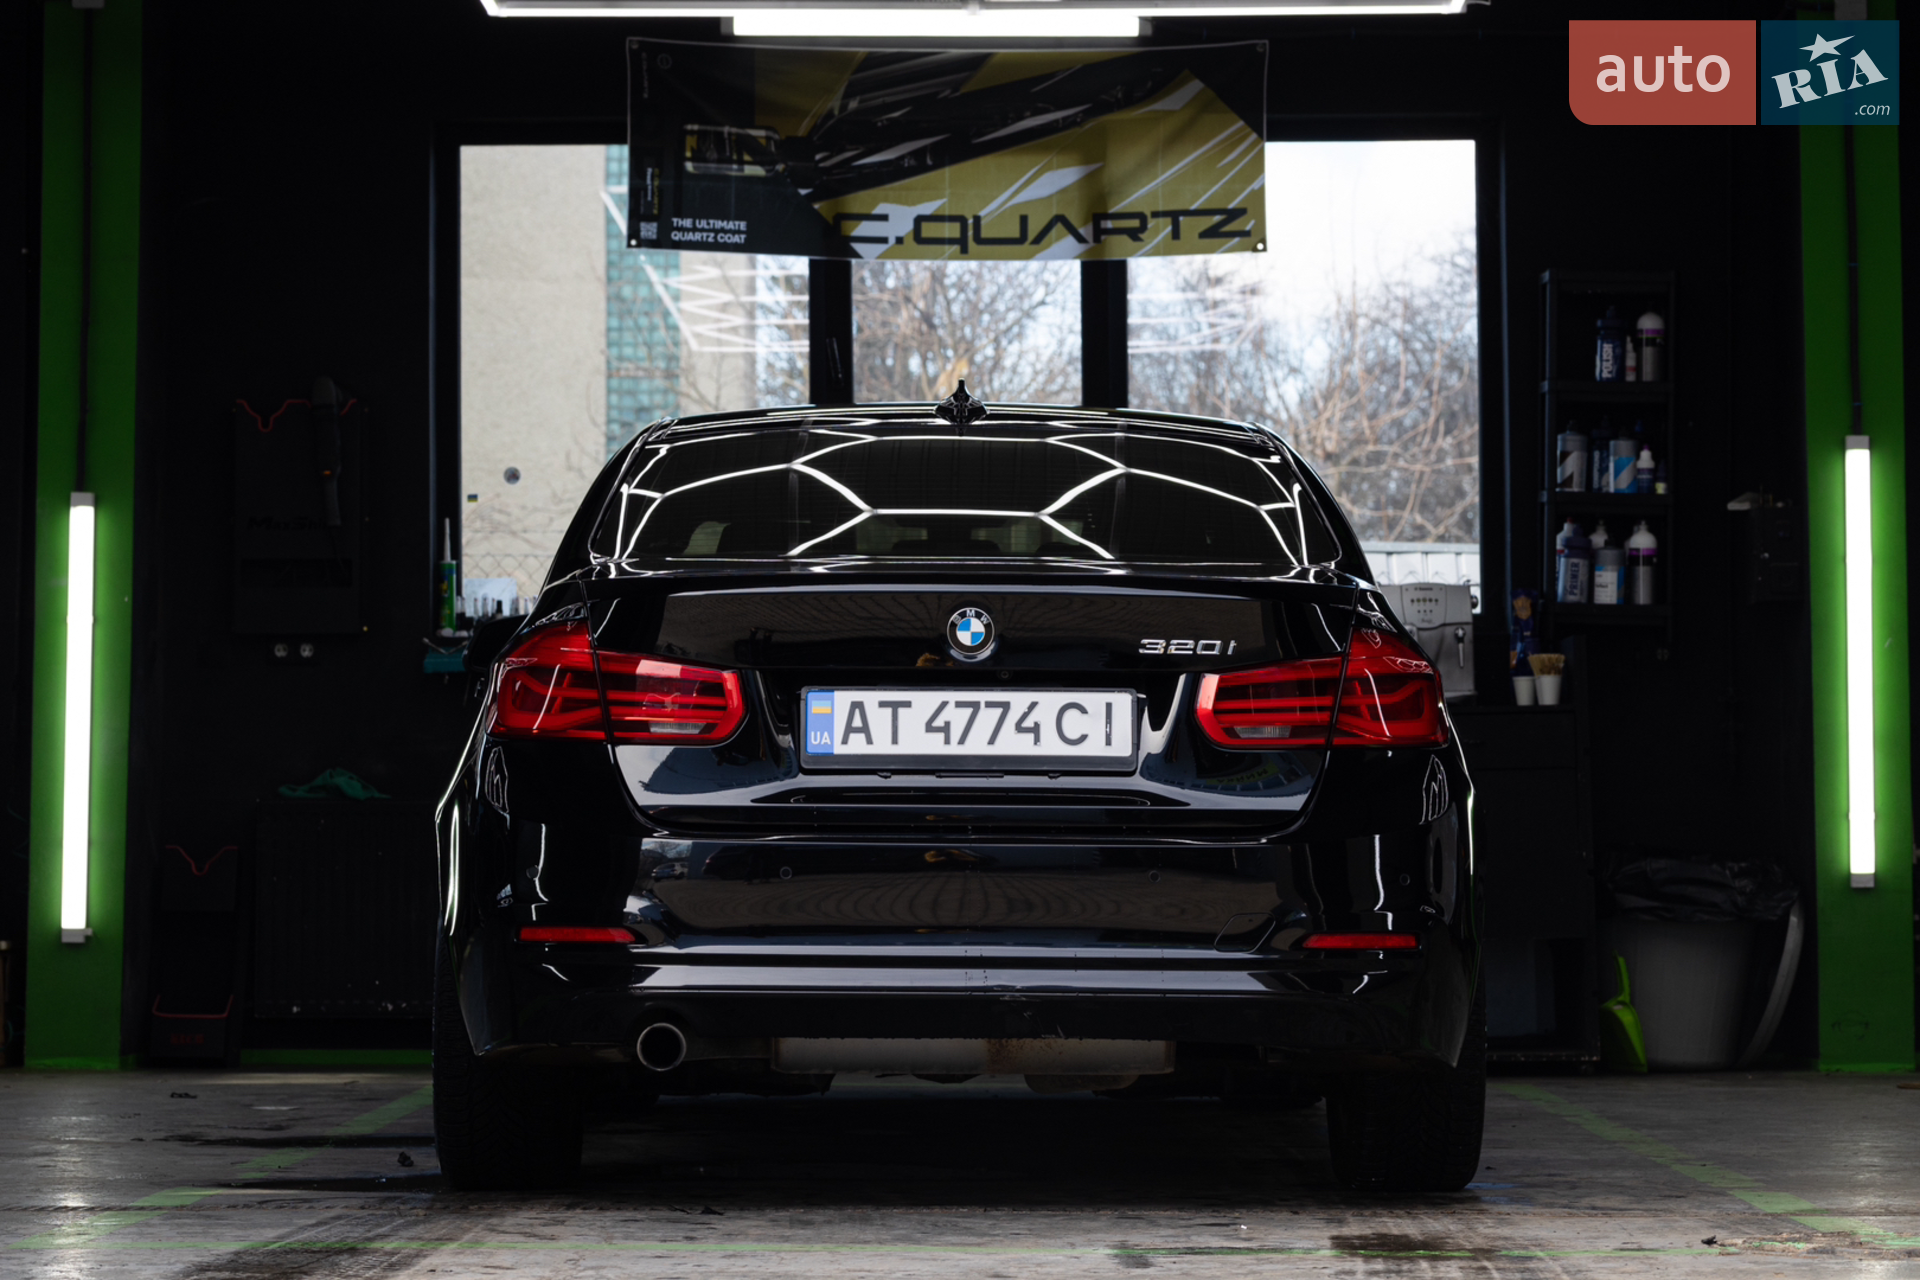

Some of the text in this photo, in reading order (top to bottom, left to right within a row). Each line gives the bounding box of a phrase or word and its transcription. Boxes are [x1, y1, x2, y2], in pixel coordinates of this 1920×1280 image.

[671, 217, 747, 231] THE ULTIMATE
[832, 207, 1251, 255] C.QUARTZ
[671, 231, 747, 245] QUARTZ COAT
[1602, 343, 1613, 378] POLISH
[247, 515, 332, 530] MaxShi
[1568, 561, 1580, 596] PRIMER
[1138, 638, 1238, 656] 320i
[841, 700, 1113, 747] AT 4774 CI
[810, 730, 832, 746] UA
